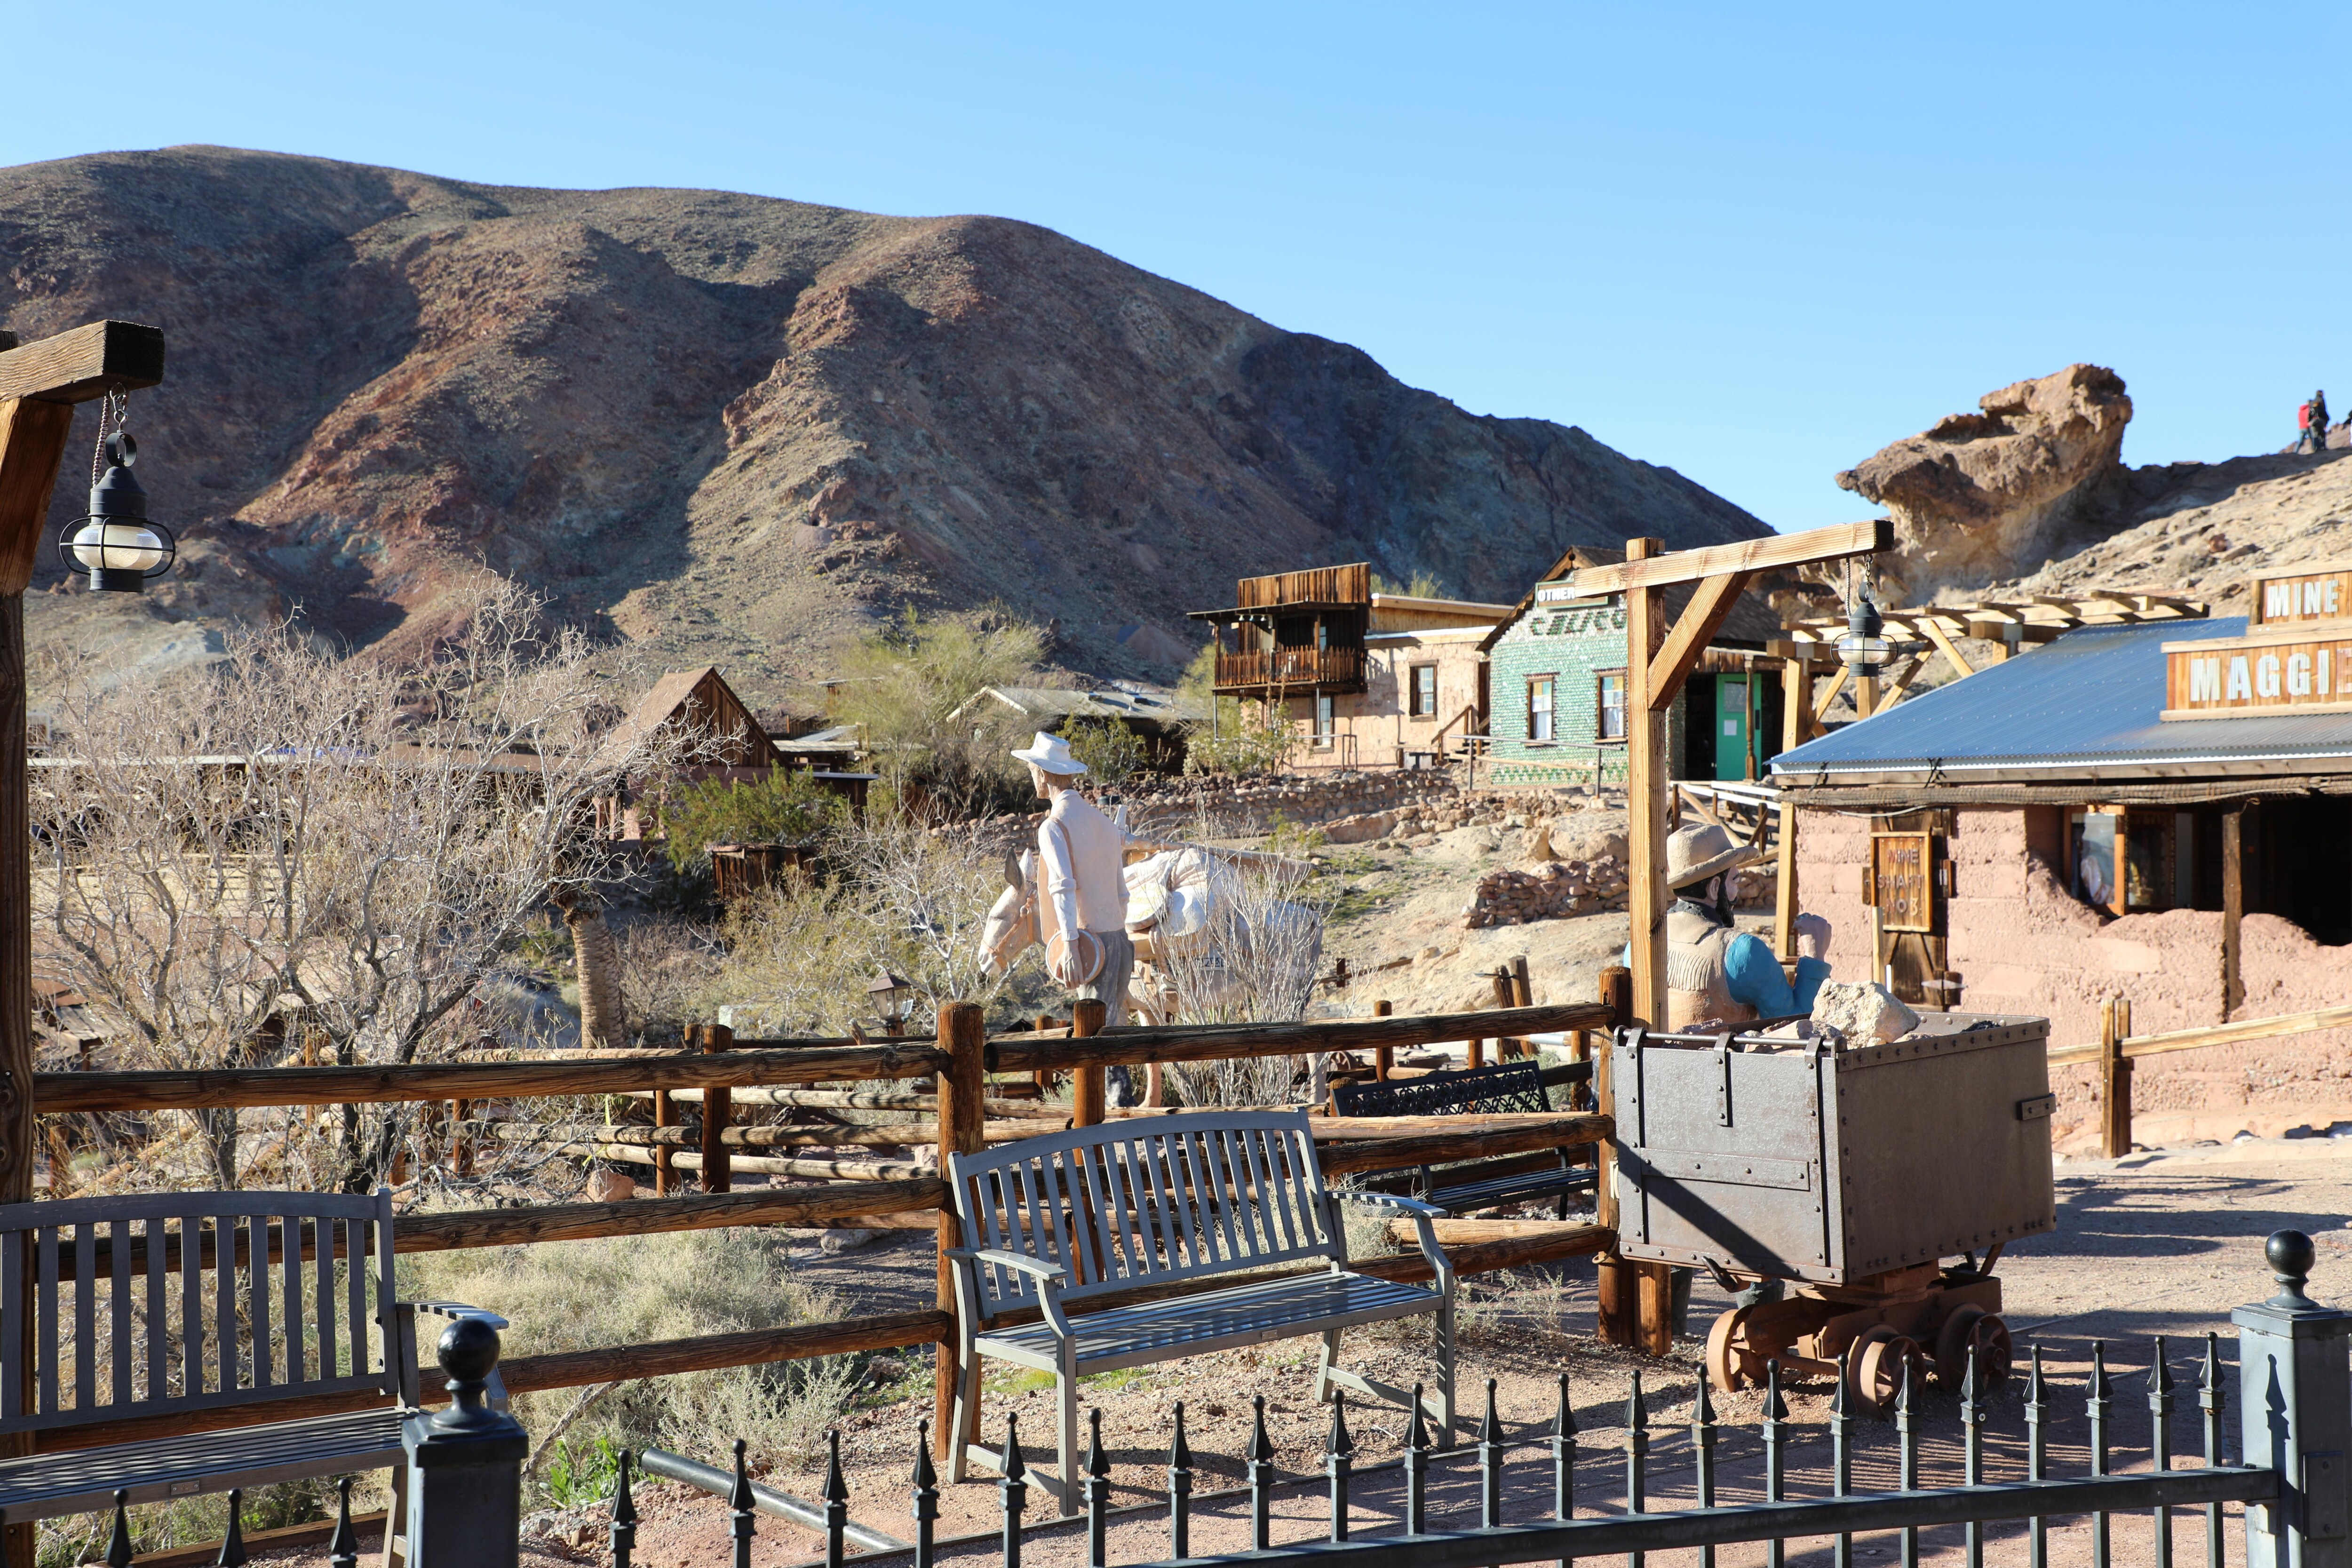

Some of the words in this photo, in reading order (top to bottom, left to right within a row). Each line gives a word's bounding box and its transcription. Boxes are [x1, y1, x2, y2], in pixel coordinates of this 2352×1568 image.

[1537, 587, 1575, 602] OTHER
[2266, 579, 2339, 618] MINE
[2190, 647, 2352, 702] MAGGIE
[1887, 848, 1920, 865] MINE
[1877, 874, 1924, 889] SHAFT
[1910, 897, 1920, 916] 3
